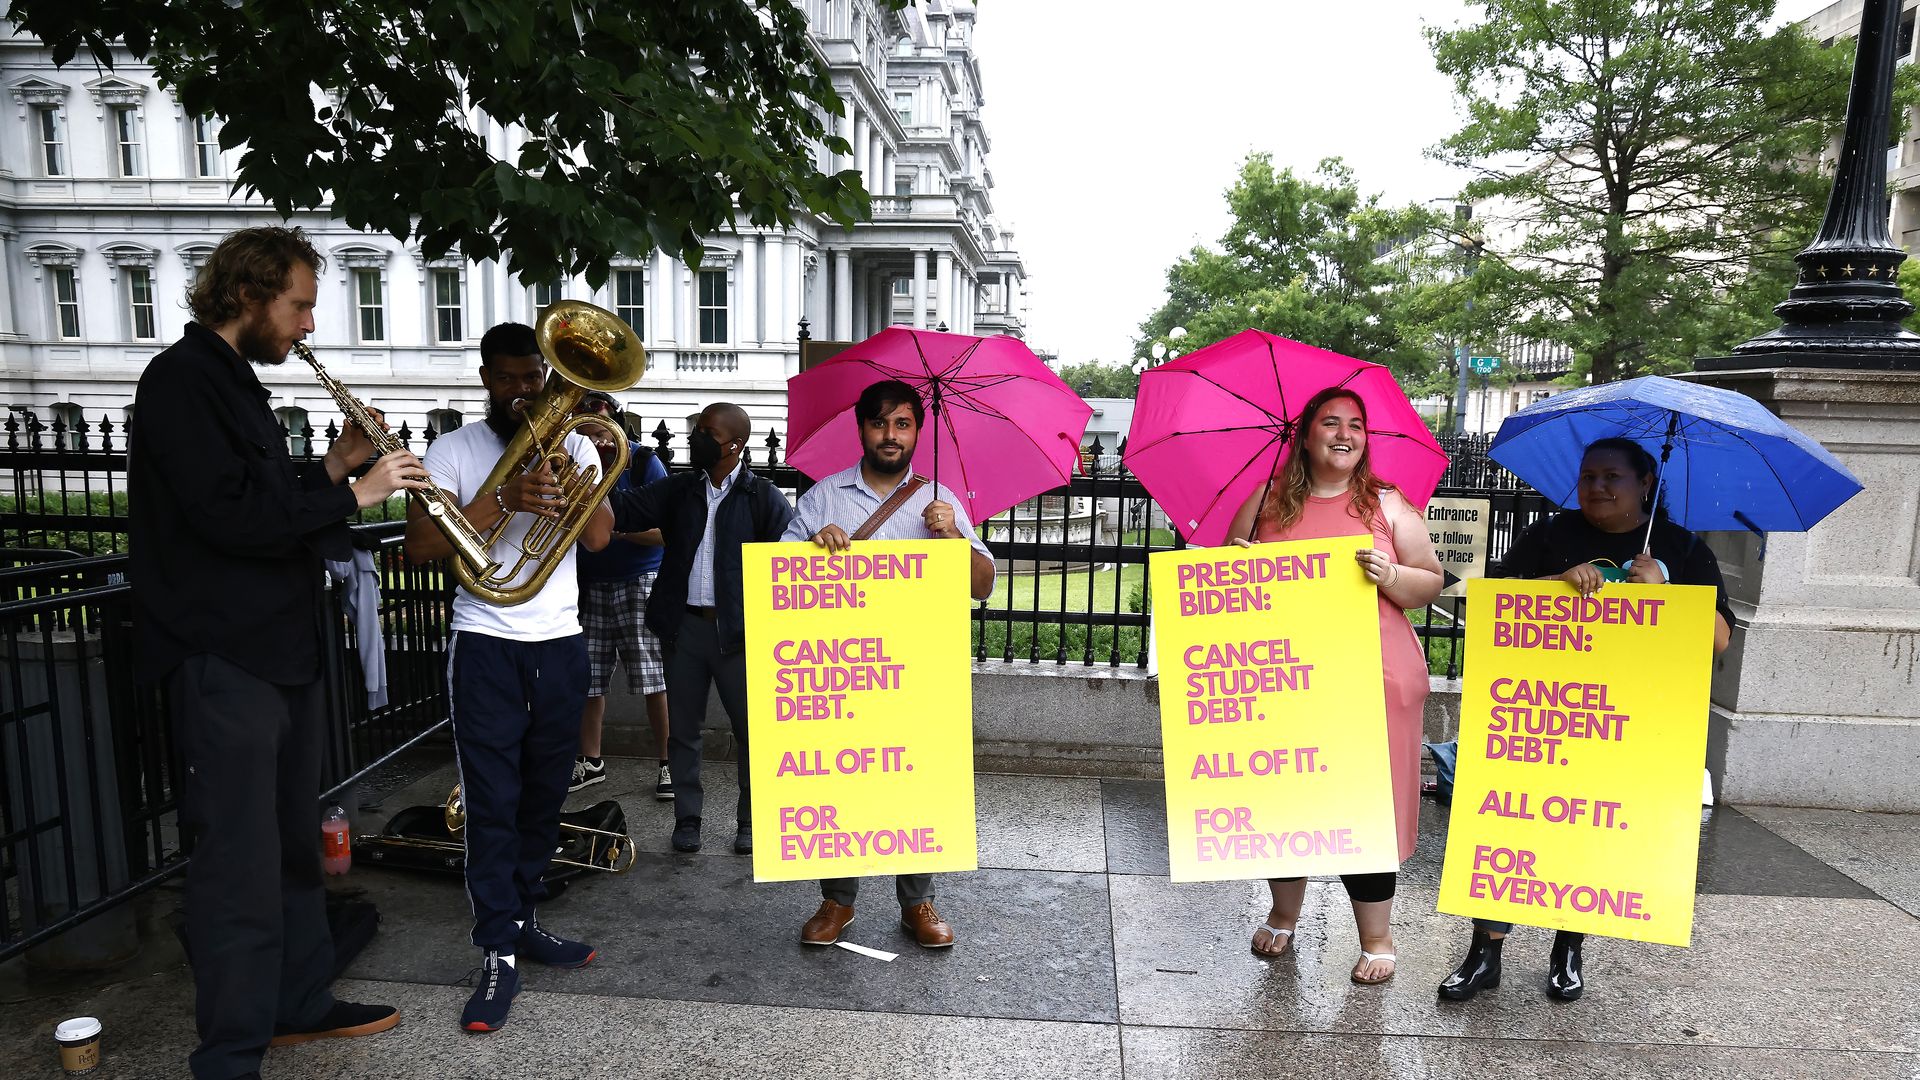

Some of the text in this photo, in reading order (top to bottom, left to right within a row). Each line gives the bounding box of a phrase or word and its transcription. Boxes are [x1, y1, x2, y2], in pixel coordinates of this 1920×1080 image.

[1477, 358, 1484, 367] G
[1428, 506, 1478, 522] Entrance
[1443, 531, 1473, 544] follow
[772, 554, 928, 583] PRESIDENT
[1177, 553, 1331, 589] PRESIDENT
[1447, 549, 1474, 563] Place
[772, 583, 866, 611] BIDEN:
[1180, 586, 1272, 616] BIDEN:
[1495, 594, 1665, 626] PRESIDENT
[774, 637, 891, 666] CANCEL
[1494, 622, 1593, 652] BIDEN:
[1183, 638, 1299, 670] CANCEL
[775, 664, 905, 694] STUDENT
[1186, 664, 1314, 698] STUDENT
[776, 694, 854, 721] DEBT.
[1489, 678, 1615, 712] CANCEL
[1187, 696, 1266, 725] DEBT.
[1488, 706, 1630, 741] STUDENT
[777, 746, 914, 777] ALL OF IT.
[1190, 747, 1328, 780] ALL OF IT.
[1485, 734, 1568, 766] DEBT.
[780, 805, 840, 833] FOR
[1194, 807, 1255, 834] FOR
[1478, 790, 1628, 830] ALL OF IT.
[781, 827, 944, 861] EVERYONE.
[1196, 829, 1362, 863] EVERYONE.
[1473, 845, 1536, 878] FOR
[1469, 873, 1652, 921] EVERYONE.
